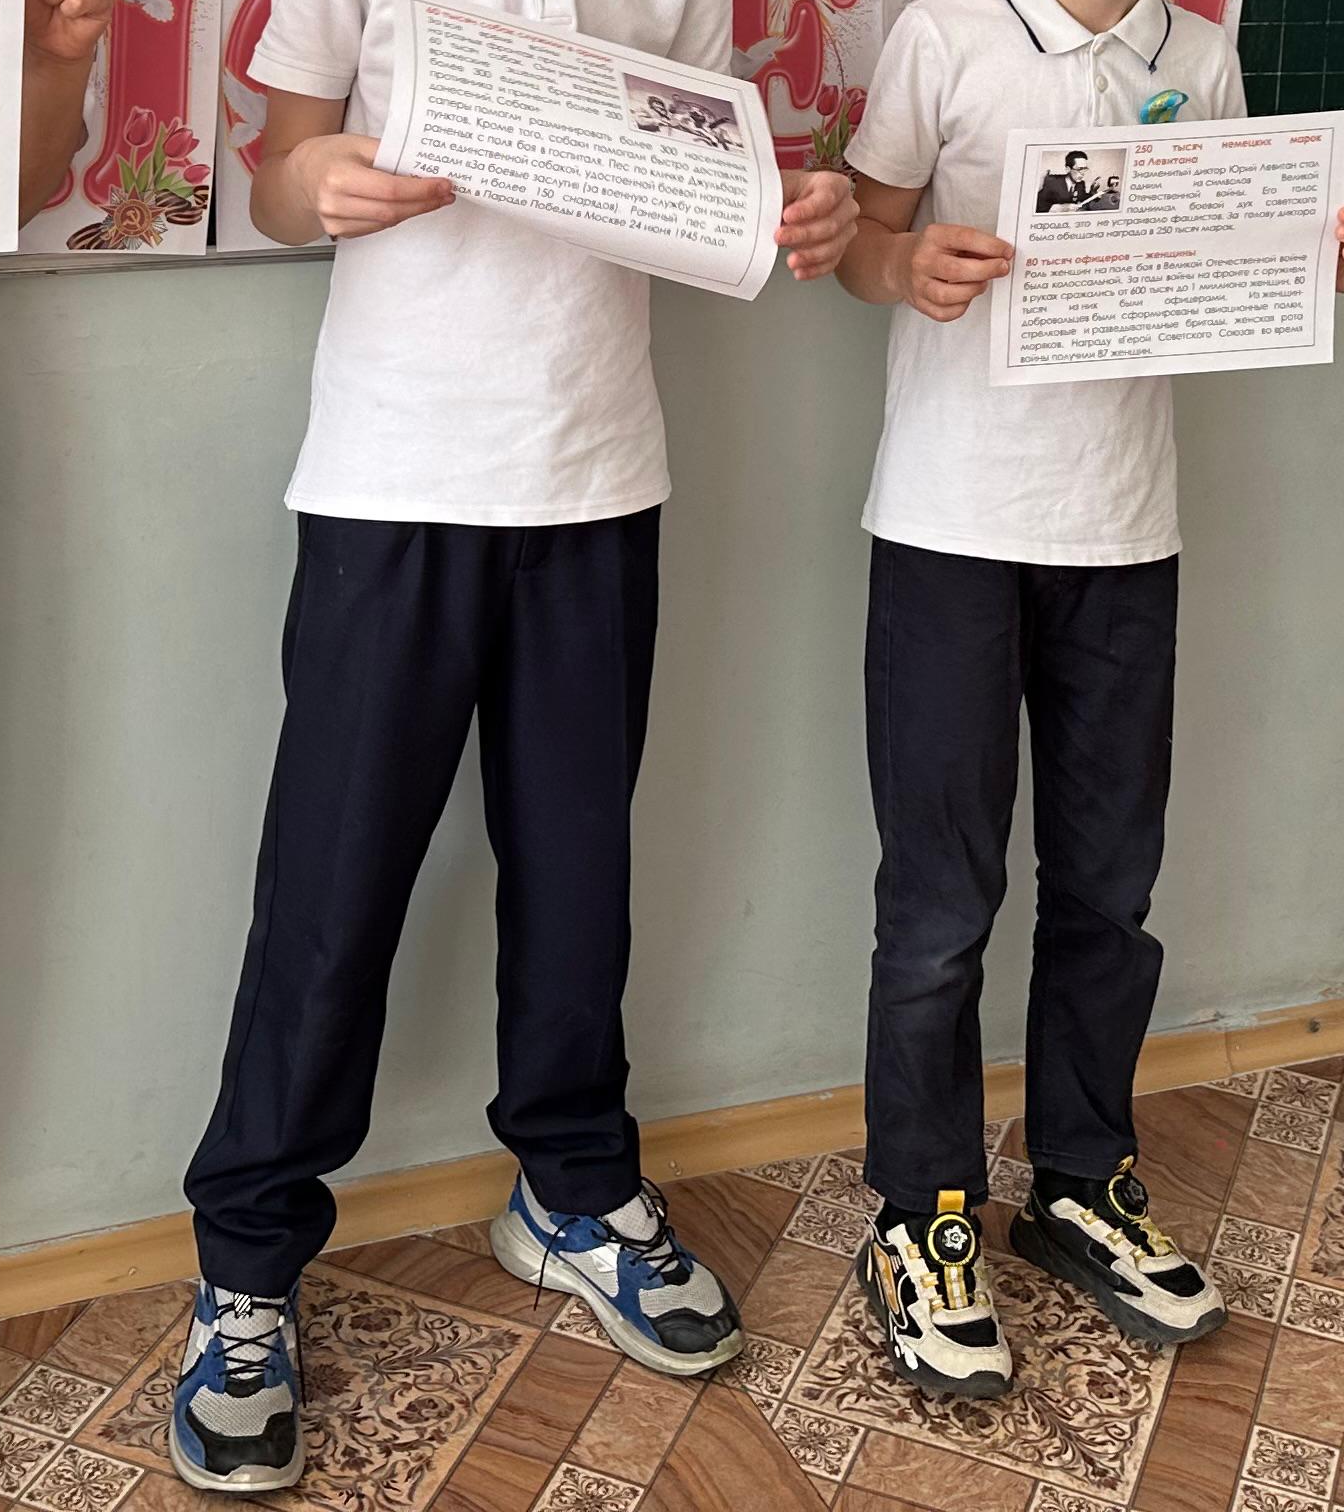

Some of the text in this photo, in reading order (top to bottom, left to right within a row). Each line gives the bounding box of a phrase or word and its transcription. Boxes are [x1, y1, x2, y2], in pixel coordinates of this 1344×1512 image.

[1136, 134, 1322, 154] 250 тысяч немецких марок
[1133, 156, 1198, 167] за Левитана
[483, 189, 527, 205] Параде
[530, 199, 574, 216] Победы
[584, 211, 626, 226] Москве
[628, 219, 641, 230] 24
[644, 225, 671, 236] июня
[676, 229, 698, 241] 1945
[700, 235, 727, 248] года.
[1025, 249, 1196, 267] 80 тысяч офицеров женщины
